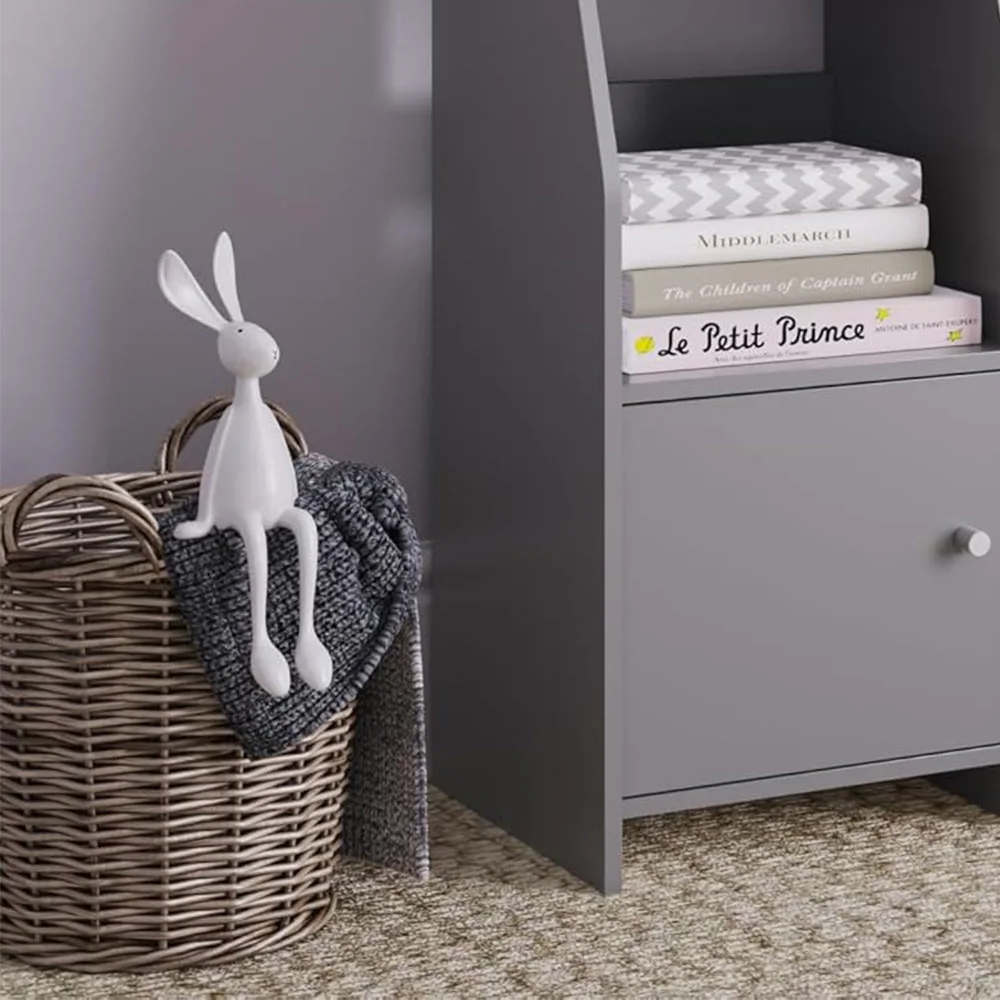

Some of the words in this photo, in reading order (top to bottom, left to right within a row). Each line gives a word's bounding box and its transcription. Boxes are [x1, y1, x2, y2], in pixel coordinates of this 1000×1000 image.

[697, 227, 852, 249] MIDDLEMARCH
[662, 286, 693, 301] The
[699, 280, 772, 300] Children
[776, 277, 794, 294] of
[800, 273, 865, 293] Captain
[870, 269, 919, 285] Grant
[658, 326, 689, 357] Le
[700, 322, 765, 352] Petit
[776, 315, 866, 346] Prince
